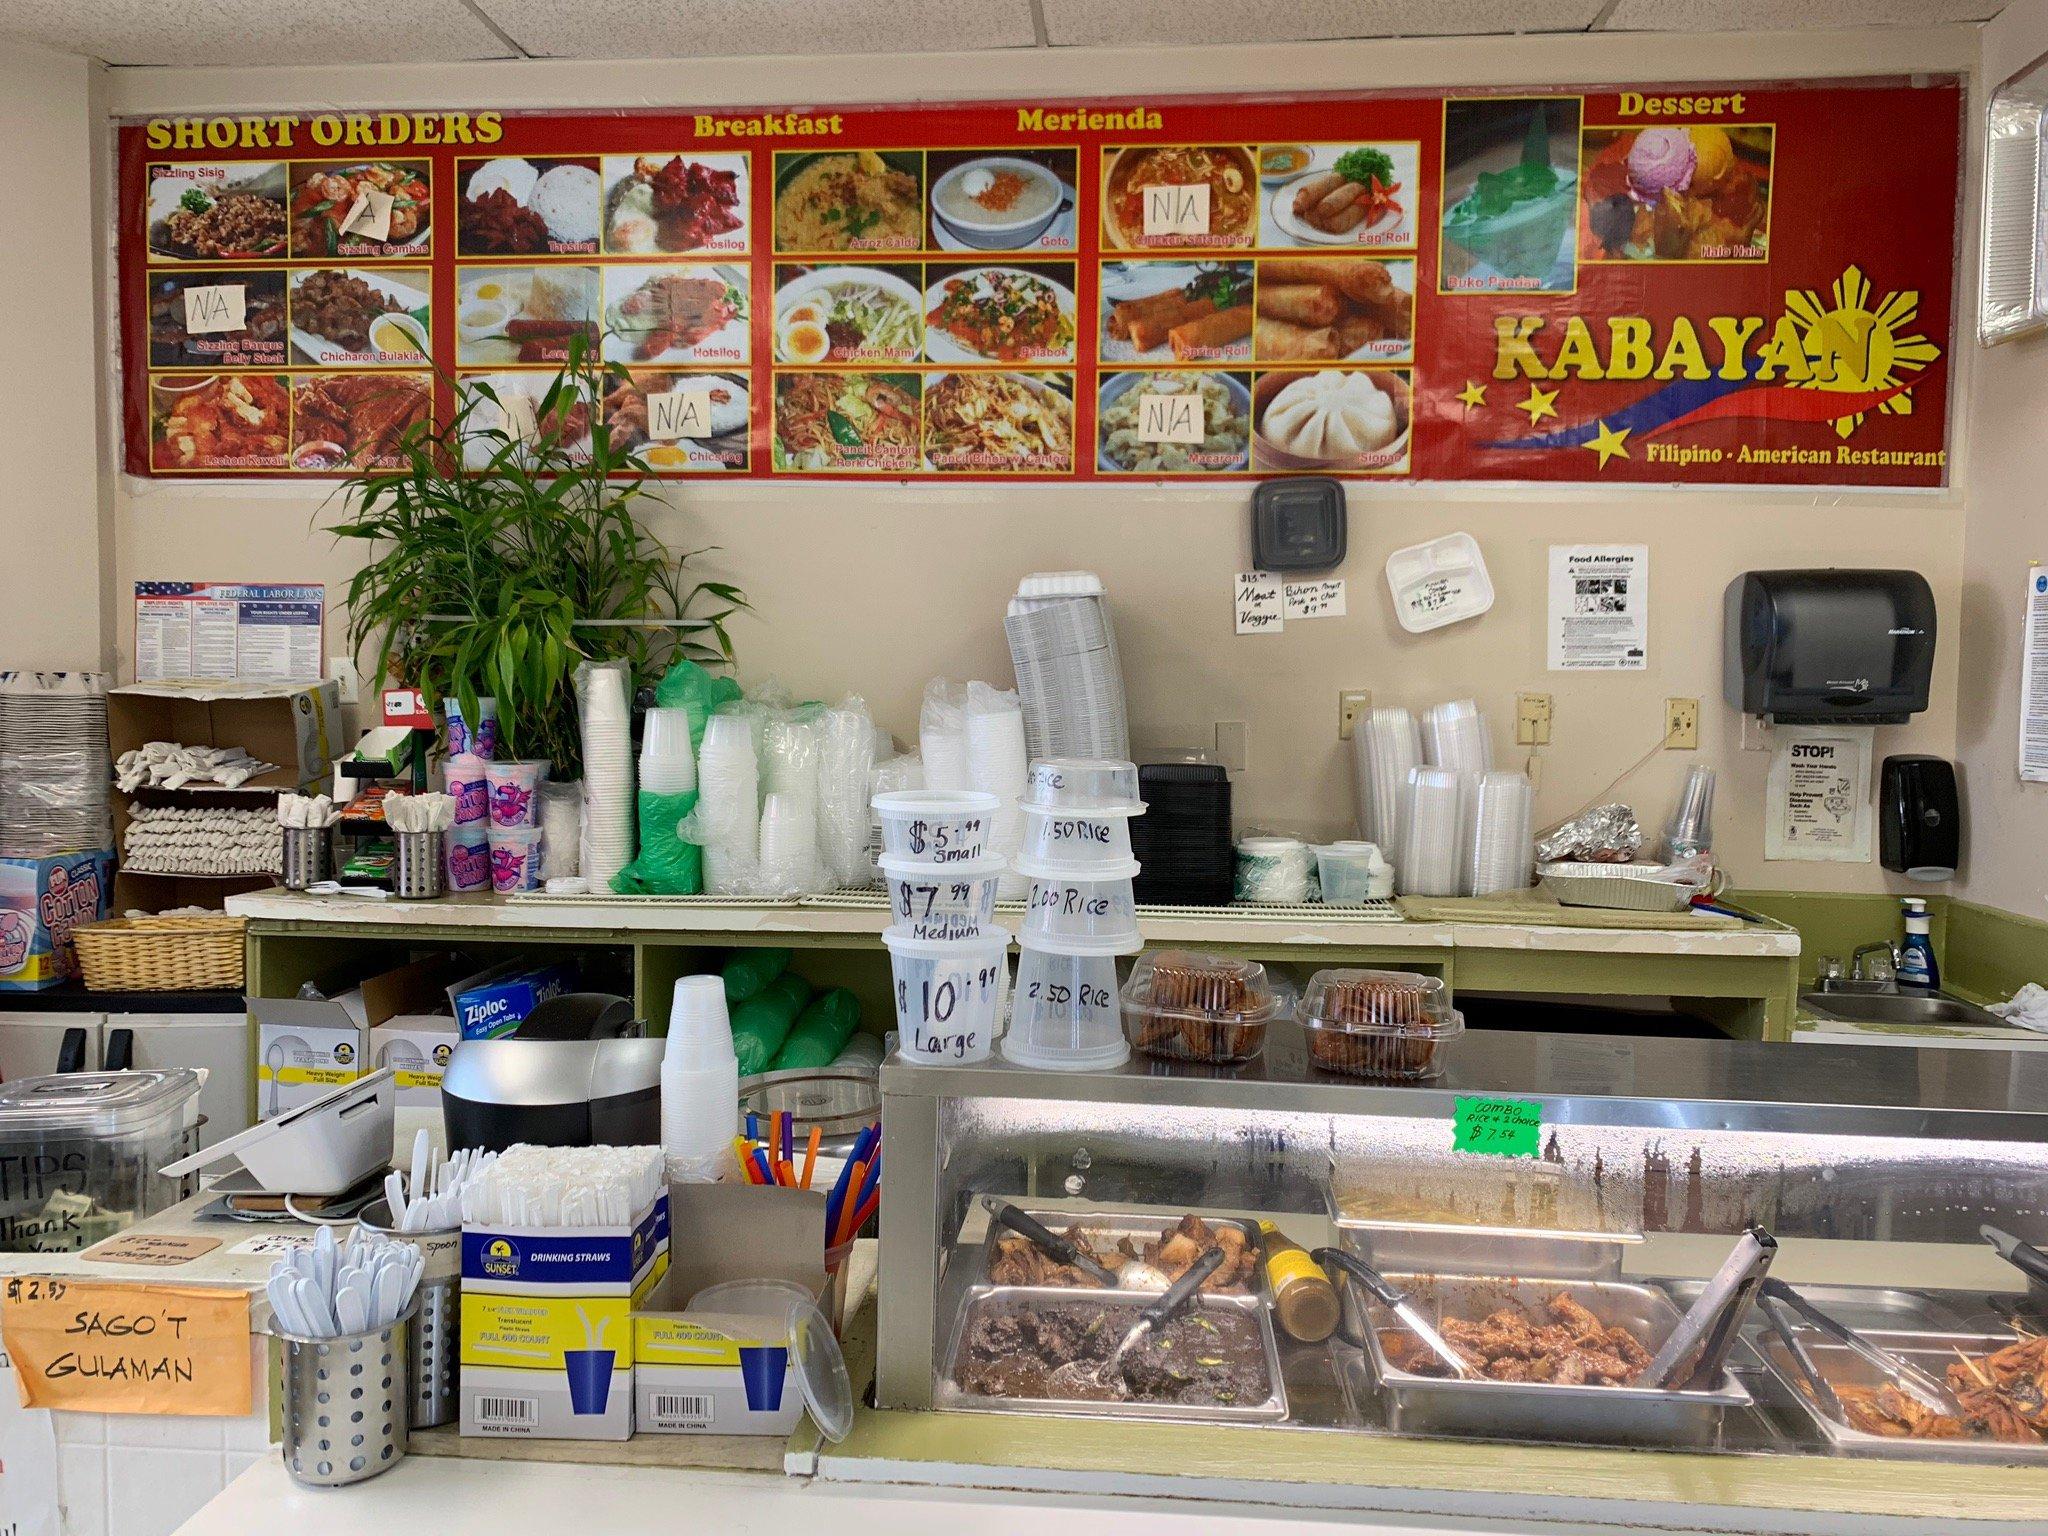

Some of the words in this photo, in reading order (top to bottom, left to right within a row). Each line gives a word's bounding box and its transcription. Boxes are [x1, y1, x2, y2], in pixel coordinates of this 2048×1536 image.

[1617, 92, 1747, 117] Dessert
[693, 114, 844, 138] Breakfast
[1017, 106, 1163, 132] Merienda
[146, 114, 300, 150] SHORT
[310, 112, 504, 146] ORDERS
[151, 167, 195, 180] Sizzling
[198, 166, 225, 180] Sisig
[1153, 187, 1200, 225] N/A
[850, 237, 882, 249] Arroz
[886, 236, 920, 248] Caldo
[1041, 235, 1070, 247] Goto
[1358, 232, 1383, 245] Egg
[1386, 231, 1410, 244] Roll
[337, 243, 381, 256] Sizzling
[383, 243, 429, 255] Gambas
[549, 240, 596, 253] Tapsilog
[1700, 244, 1731, 258] Halo
[1733, 244, 1764, 258] Halo
[1447, 275, 1484, 289] Buko
[1488, 274, 1543, 289] Pandan
[190, 287, 229, 326] N/A
[197, 340, 240, 353] Sizzling
[242, 340, 285, 353] Bangus
[693, 346, 741, 359] Hotsilog
[833, 347, 881, 359] Chicken
[883, 346, 916, 359] Mami
[1020, 346, 1069, 358] Palabok
[1181, 345, 1222, 360] Spring
[1223, 344, 1249, 356] Roll
[1369, 341, 1404, 354] Turon
[1492, 315, 1878, 384] KABAYAN
[223, 352, 251, 367] Belly
[253, 352, 285, 365] Steak
[320, 350, 378, 363] Chicharon
[378, 350, 427, 363] Bulaklak
[656, 394, 700, 434] N/A
[1147, 400, 1192, 436] N/A
[835, 444, 873, 456] Pancit
[875, 444, 917, 456] Canton
[1646, 443, 1723, 466] Filipino
[1738, 443, 1832, 466] American
[1836, 445, 1946, 468] Restaurant
[205, 454, 246, 467] Lechon
[249, 454, 285, 467] Kawali
[688, 451, 744, 465] Chicsilog
[932, 452, 969, 465] Pancit
[971, 452, 1008, 465] Bihon
[1026, 453, 1069, 465] Canton
[1188, 452, 1244, 464] Macaroni
[1360, 452, 1403, 465] Siopao
[1569, 555, 1592, 563] Food
[1593, 555, 1634, 564] Allergies
[219, 589, 262, 600] FEDERAL
[263, 589, 293, 600] LABOR
[294, 589, 323, 600] LAWS
[1238, 587, 1277, 602] Meat
[1286, 585, 1318, 598] Bihon
[1791, 744, 1835, 759] STOP!
[1043, 821, 1075, 841] 1.50
[40, 872, 100, 928] COTTON
[1028, 982, 1071, 1003] 2.50
[465, 998, 508, 1027] Ziploc
[475, 1025, 488, 1036] Easy
[488, 1018, 503, 1029] Open
[503, 1012, 516, 1024] Tabs
[914, 1028, 977, 1059] Large
[306, 1070, 324, 1078] Heavy
[324, 1071, 346, 1079] Weight
[408, 1073, 426, 1081] Heavy
[0, 1153, 87, 1202] TIPS
[0, 1209, 80, 1242] Thank
[530, 1252, 574, 1263] DRINKING
[575, 1252, 612, 1263] STRAWS
[485, 1262, 517, 1276] SUNSET
[497, 1316, 533, 1325] Translucent
[480, 1332, 501, 1342] FULL
[520, 1334, 551, 1345] COUNT
[654, 1331, 675, 1340] FULL
[45, 1351, 193, 1382] GULAMAN
